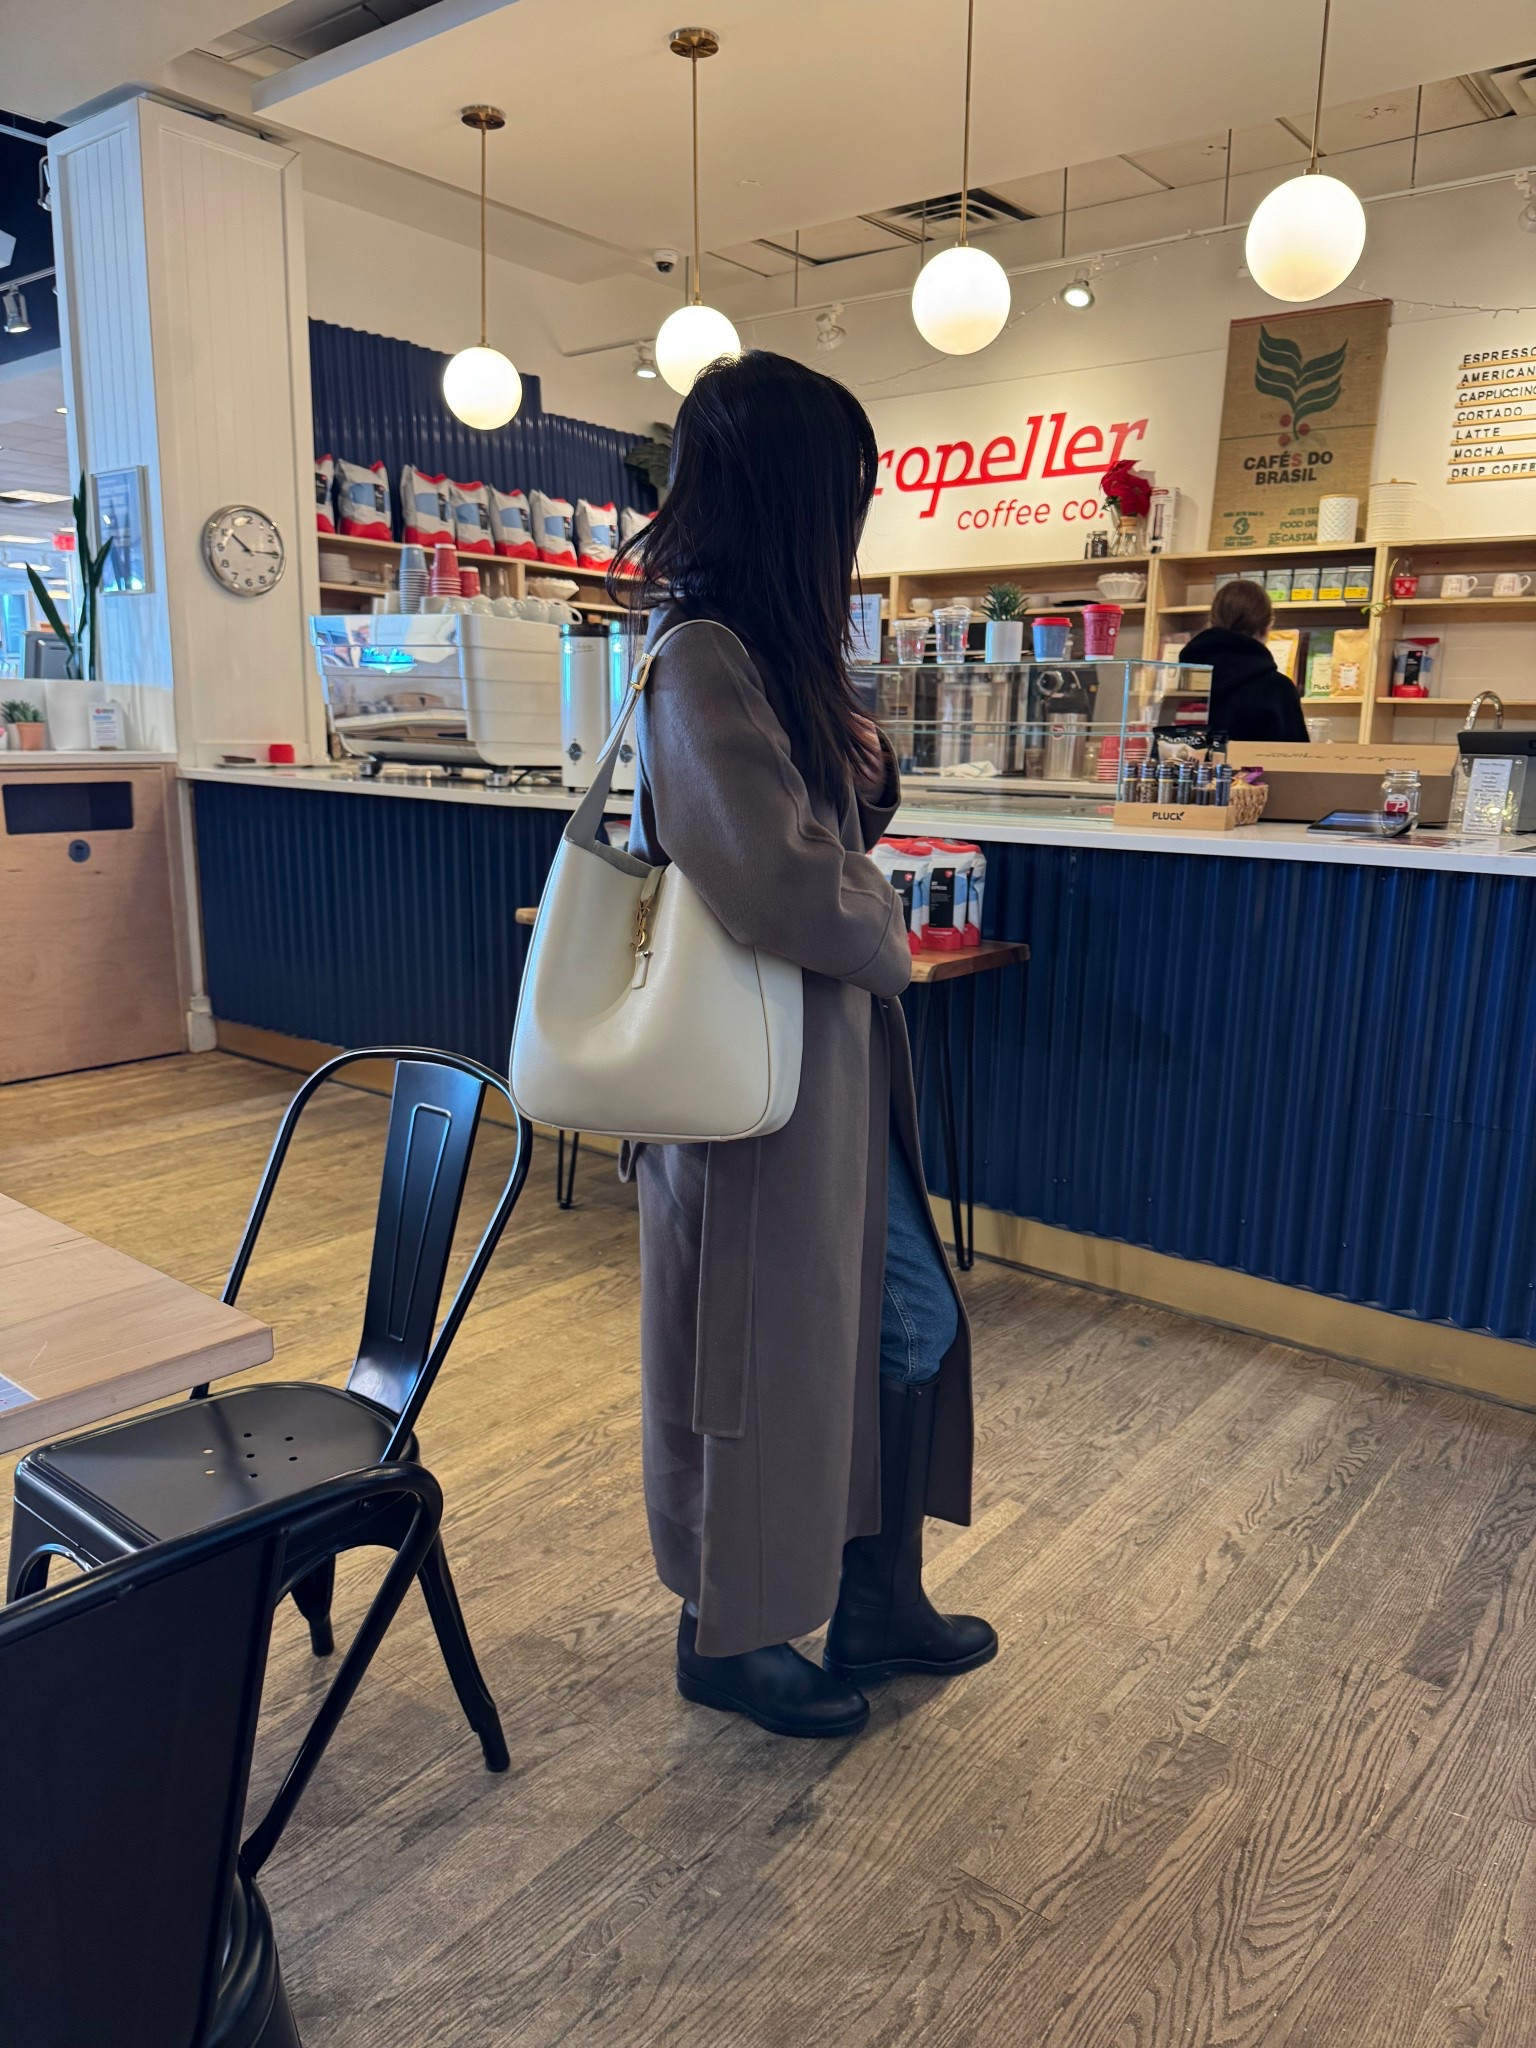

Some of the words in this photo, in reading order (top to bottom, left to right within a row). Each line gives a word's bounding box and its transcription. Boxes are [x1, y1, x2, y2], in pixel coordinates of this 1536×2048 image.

[1457, 406, 1523, 422] CORTADO
[1456, 427, 1501, 440] LATTE
[1454, 446, 1505, 458] MOCHA
[1243, 451, 1302, 470] CAFÉS
[1307, 451, 1334, 466] DO
[1255, 469, 1317, 486] BRASIL
[1451, 466, 1486, 478] DRIP
[957, 499, 1051, 531] coffee
[1062, 499, 1105, 522] co.
[1280, 521, 1304, 530] FOOD
[1151, 811, 1185, 821] PLUCK
